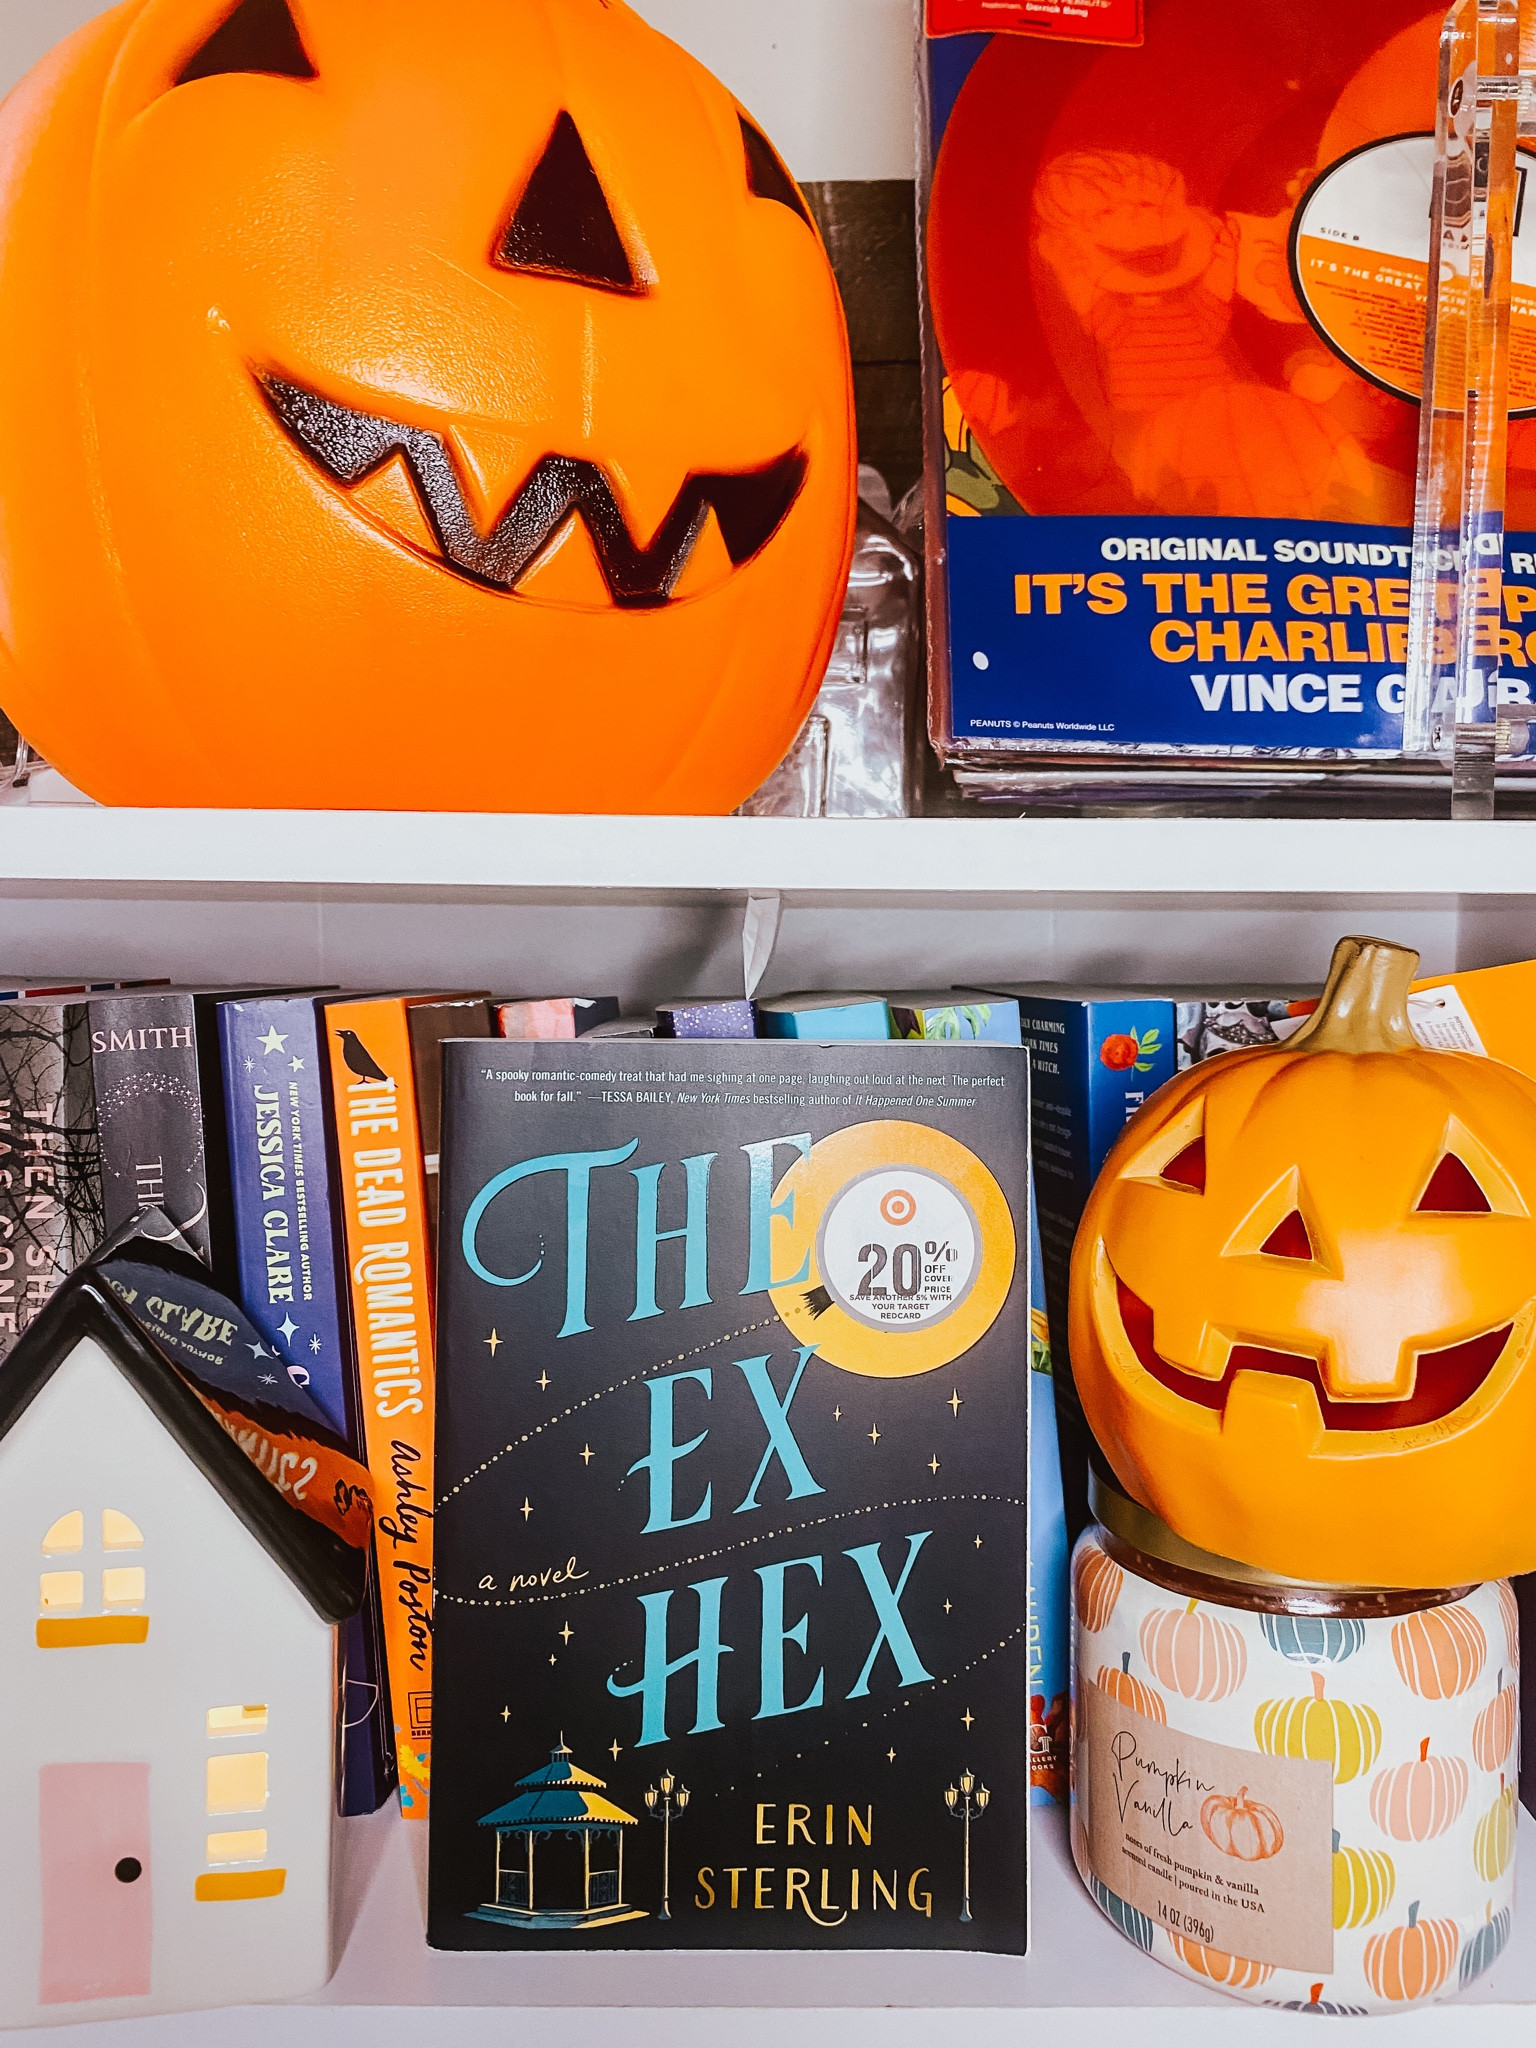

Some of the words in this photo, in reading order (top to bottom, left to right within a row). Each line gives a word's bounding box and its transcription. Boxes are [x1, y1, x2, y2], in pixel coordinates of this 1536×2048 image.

[1320, 226, 1348, 239] SIDE
[1342, 265, 1370, 280] THE
[1374, 273, 1423, 291] GREAT
[1100, 536, 1268, 563] ORIGINAL
[1013, 573, 1129, 615] IT'S
[1142, 573, 1273, 615] THE
[1189, 672, 1362, 713] VINCE
[970, 719, 1011, 728] PEANUTS
[1021, 720, 1055, 730] Peanuts
[1055, 722, 1097, 731] Worldwide
[1098, 723, 1115, 732] LLC
[91, 1026, 194, 1054] SMITH
[1038, 1040, 1059, 1054] TIMES
[288, 1081, 299, 1107] NEW
[496, 1069, 530, 1084] spooky
[531, 1070, 616, 1084] romantic-comedy
[618, 1071, 643, 1082] treat
[645, 1070, 666, 1082] that
[668, 1071, 688, 1083] had
[690, 1073, 705, 1083] me
[707, 1072, 743, 1085] sighing
[746, 1073, 757, 1083] at
[758, 1074, 776, 1083] one
[808, 1073, 851, 1086] laughing
[853, 1074, 869, 1085] out
[872, 1074, 892, 1085] loud
[895, 1075, 905, 1085] at
[908, 1075, 924, 1086] the
[952, 1075, 969, 1086] The
[971, 1075, 1005, 1088] perfect
[514, 1091, 538, 1102] book
[540, 1091, 555, 1102] for
[636, 1092, 674, 1104] BAILEY,
[676, 1093, 698, 1103] New
[701, 1093, 721, 1103] York
[723, 1092, 751, 1104] Times
[753, 1093, 806, 1106] bestselling
[808, 1094, 840, 1105] author
[842, 1095, 852, 1105] of
[865, 1095, 913, 1108] Happened
[915, 1096, 934, 1106] One
[936, 1096, 977, 1107] Summer
[290, 1109, 302, 1140] YORK
[347, 1076, 400, 1137] THE
[23, 1103, 55, 1220] THEN
[253, 1083, 287, 1201] JESSICA
[292, 1142, 305, 1177] TIMES
[353, 1147, 407, 1228] DEAD
[295, 1179, 310, 1251] BESTSELLING
[462, 1133, 814, 1338] THE
[262, 1209, 295, 1305] CLARE
[300, 1253, 313, 1301] AUTHOR
[924, 1264, 946, 1274] OFF
[627, 1344, 827, 1535] EX
[478, 1570, 497, 1591] a
[508, 1556, 590, 1592] novel
[393, 1560, 435, 1672] Poston
[606, 1531, 935, 1748] HEX
[1031, 1763, 1055, 1771] OOKS
[1111, 1731, 1214, 1797] Pumpkin
[755, 1803, 874, 1847] ERIN
[1113, 1772, 1193, 1836] Vanilla
[1121, 1846, 1147, 1868] scented
[1147, 1863, 1173, 1882] candle
[1178, 1878, 1209, 1898] poured
[1211, 1890, 1221, 1902] in
[1223, 1894, 1239, 1906] the
[1241, 1898, 1266, 1914] USA
[1125, 1833, 1143, 1849] notes
[1144, 1845, 1153, 1854] of
[1153, 1849, 1173, 1866] fresh
[1174, 1861, 1213, 1883] pumpkin
[1214, 1874, 1225, 1886] &
[1225, 1879, 1259, 1895] vanilla
[694, 1867, 934, 1927] STERLING
[1157, 1900, 1168, 1921] 14
[1169, 1908, 1181, 1928] OZ
[1183, 1914, 1214, 1944] (396g)
